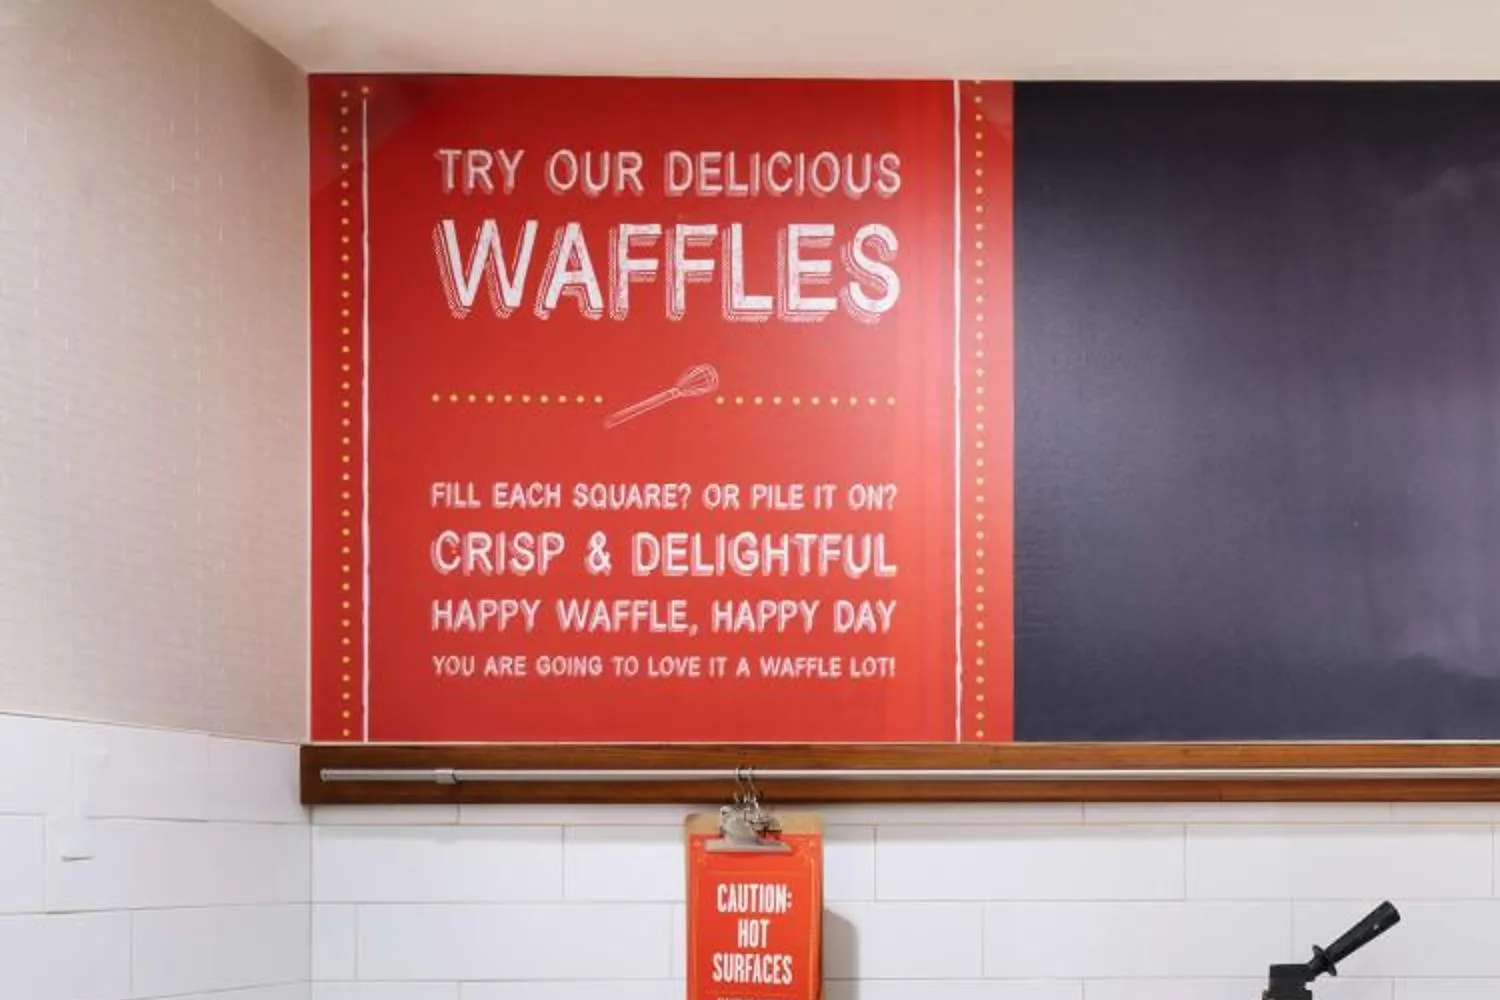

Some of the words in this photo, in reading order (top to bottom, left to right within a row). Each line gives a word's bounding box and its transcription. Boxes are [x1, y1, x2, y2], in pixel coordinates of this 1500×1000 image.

[434, 148, 525, 195] TRY
[545, 149, 644, 196] OUR
[664, 150, 901, 197] DELICIOUS
[432, 218, 901, 323] WAFFLES
[431, 481, 481, 508] FILL
[492, 481, 561, 508] EACH
[572, 481, 692, 510] SQUARE?
[702, 483, 740, 509] OR
[750, 483, 804, 509] PILE
[814, 484, 836, 509] IT
[848, 484, 897, 509] ON?
[430, 530, 565, 575] CRISP
[584, 530, 612, 575] &
[631, 531, 897, 577] DELIGHTFUL
[431, 598, 541, 632] HAPPY
[556, 599, 698, 635] WAFFLE,
[711, 600, 820, 632] HAPPY
[833, 600, 896, 633] DAY
[432, 655, 475, 677] YOU
[484, 655, 527, 677] ARE
[535, 655, 603, 678] GOING
[612, 656, 639, 677] TO
[647, 656, 701, 677] LOVE
[709, 656, 728, 677] IT
[736, 656, 751, 677] A
[760, 656, 842, 678] WAFFLE
[850, 656, 896, 678] LOT!
[717, 883, 792, 914] CAUTION:
[737, 919, 769, 949] HOT
[712, 953, 792, 985] SURFACES
